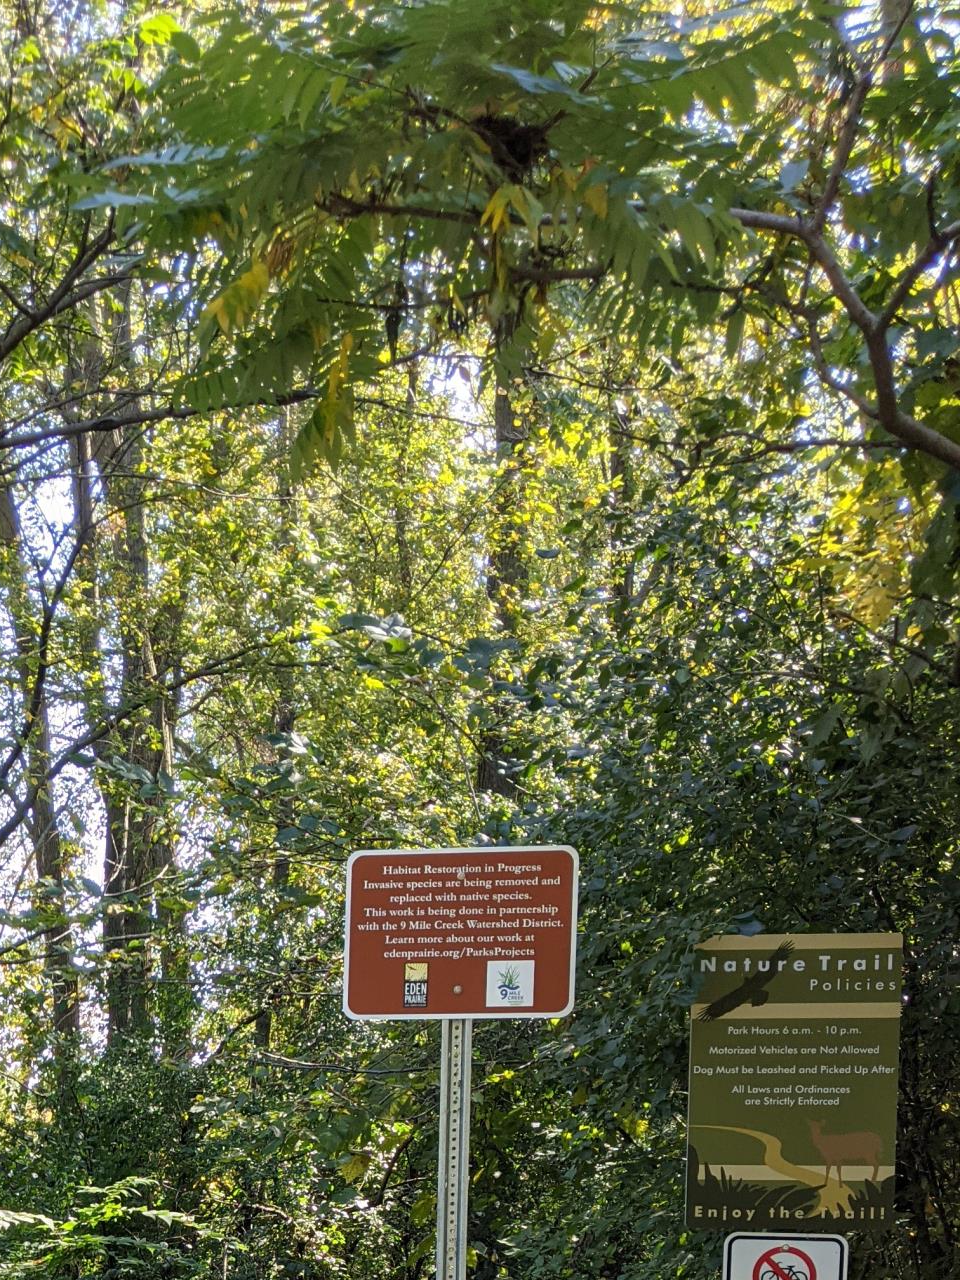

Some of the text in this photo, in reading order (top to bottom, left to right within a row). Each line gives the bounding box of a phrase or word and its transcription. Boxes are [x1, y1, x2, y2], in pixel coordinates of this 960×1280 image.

[383, 863, 541, 875] Habitat Restoration in Progress
[364, 880, 404, 889] Invasive
[406, 879, 442, 890] species
[464, 877, 492, 889] being
[495, 877, 538, 886] removed
[541, 876, 560, 885] and
[390, 891, 532, 905] replaced with native species.
[364, 904, 558, 918] This work is being done in partnership
[358, 918, 564, 931] with the 9 Mile Creek Watershed District.
[385, 935, 414, 944] Learn
[446, 934, 474, 943] about
[497, 933, 522, 942] work
[384, 946, 534, 960] edenprairie.org/ParksProjects
[700, 954, 893, 972] Nature Trail
[405, 982, 427, 995] EDEN
[810, 979, 896, 991] Policies
[405, 995, 427, 1004] PRAIRIE
[500, 989, 508, 1000] 9
[728, 1026, 748, 1035] Park
[752, 1026, 780, 1035] Hours
[782, 1026, 789, 1034] 6
[825, 1026, 837, 1034] 10
[709, 1046, 756, 1054] Motorized
[760, 1046, 798, 1054] Vehicles
[820, 1046, 838, 1054] Not
[840, 1045, 880, 1054] Allowed
[693, 1065, 895, 1075] Dog Must be Leashed and Picked Up After
[732, 1085, 850, 1094] All Laws and Ordinances
[763, 1097, 795, 1107] Strictly
[798, 1097, 840, 1106] Enforced
[694, 1205, 756, 1221] Enjoy
[769, 1206, 805, 1219] the
